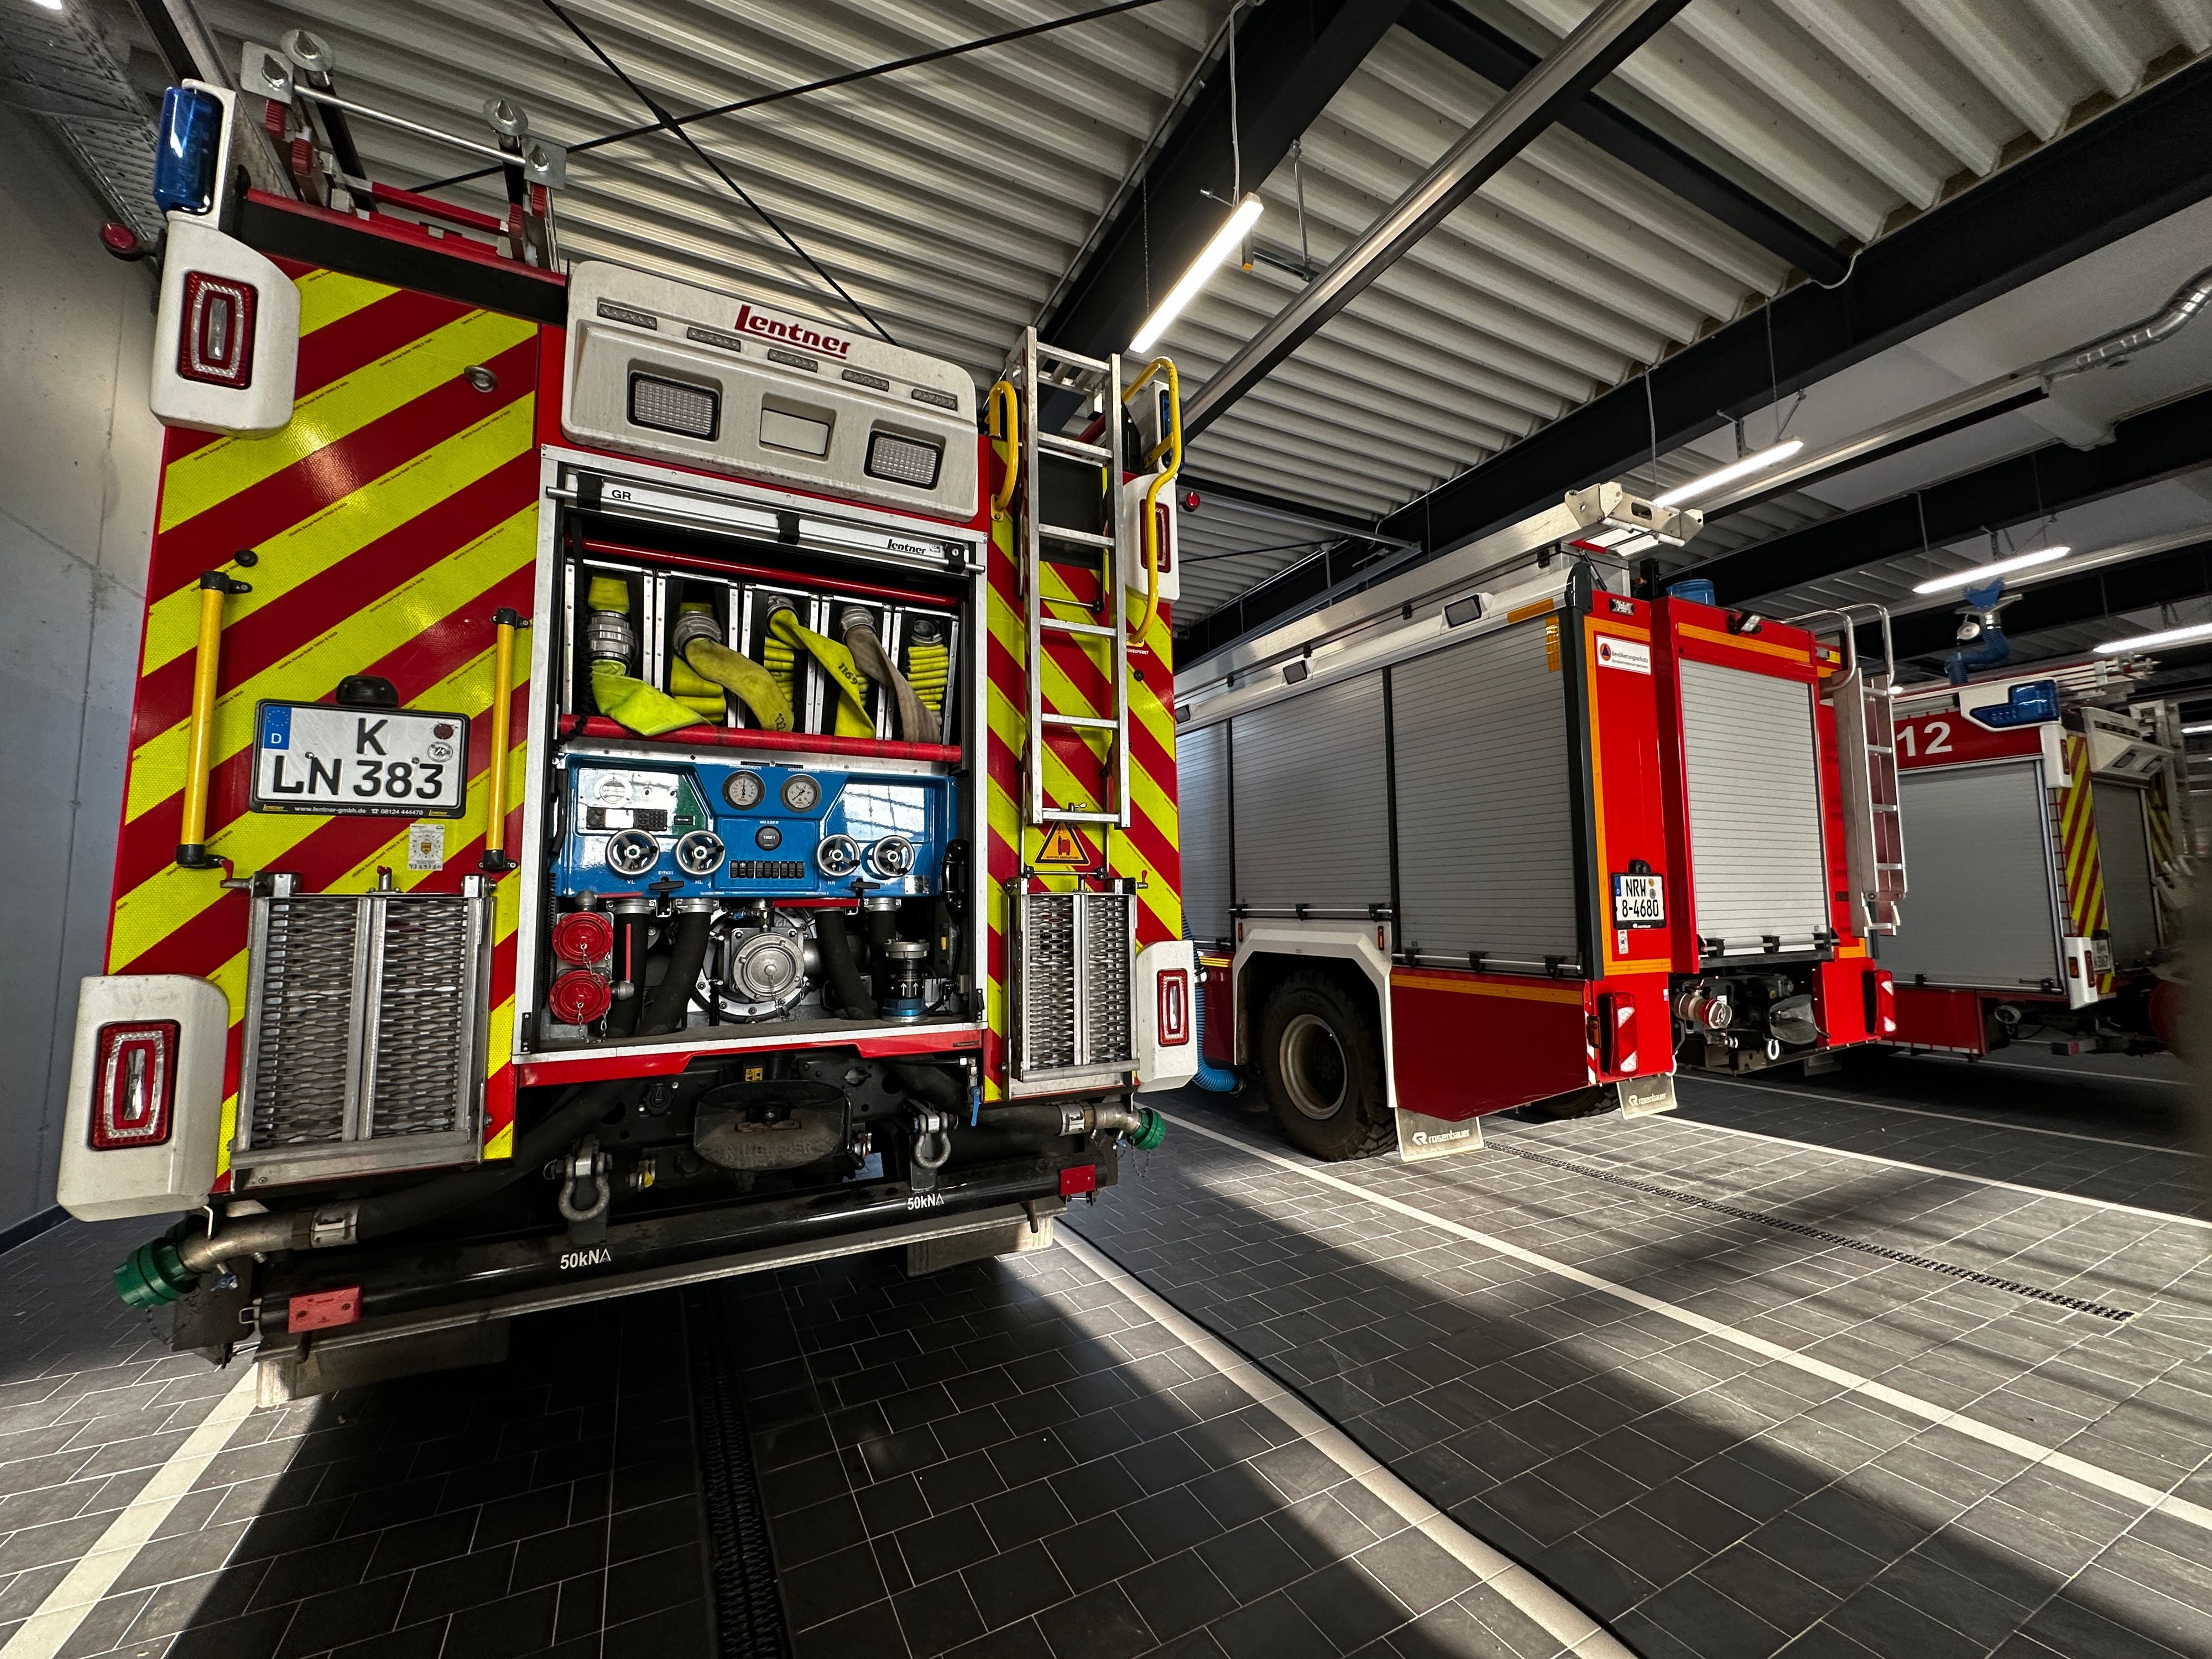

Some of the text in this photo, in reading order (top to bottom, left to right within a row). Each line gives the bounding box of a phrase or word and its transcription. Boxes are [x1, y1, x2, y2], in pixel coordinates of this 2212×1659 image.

[734, 304, 851, 359] Lentner
[612, 489, 632, 500] GR
[838, 662, 858, 685] 1169
[271, 733, 281, 744] D
[357, 718, 388, 755] K
[273, 756, 444, 799] LN 383
[294, 805, 366, 814] www.lentner-gmbh.de
[1625, 879, 1646, 897] NRW
[1621, 899, 1659, 917] 8-4680
[1428, 1129, 1470, 1144] rosenbauer
